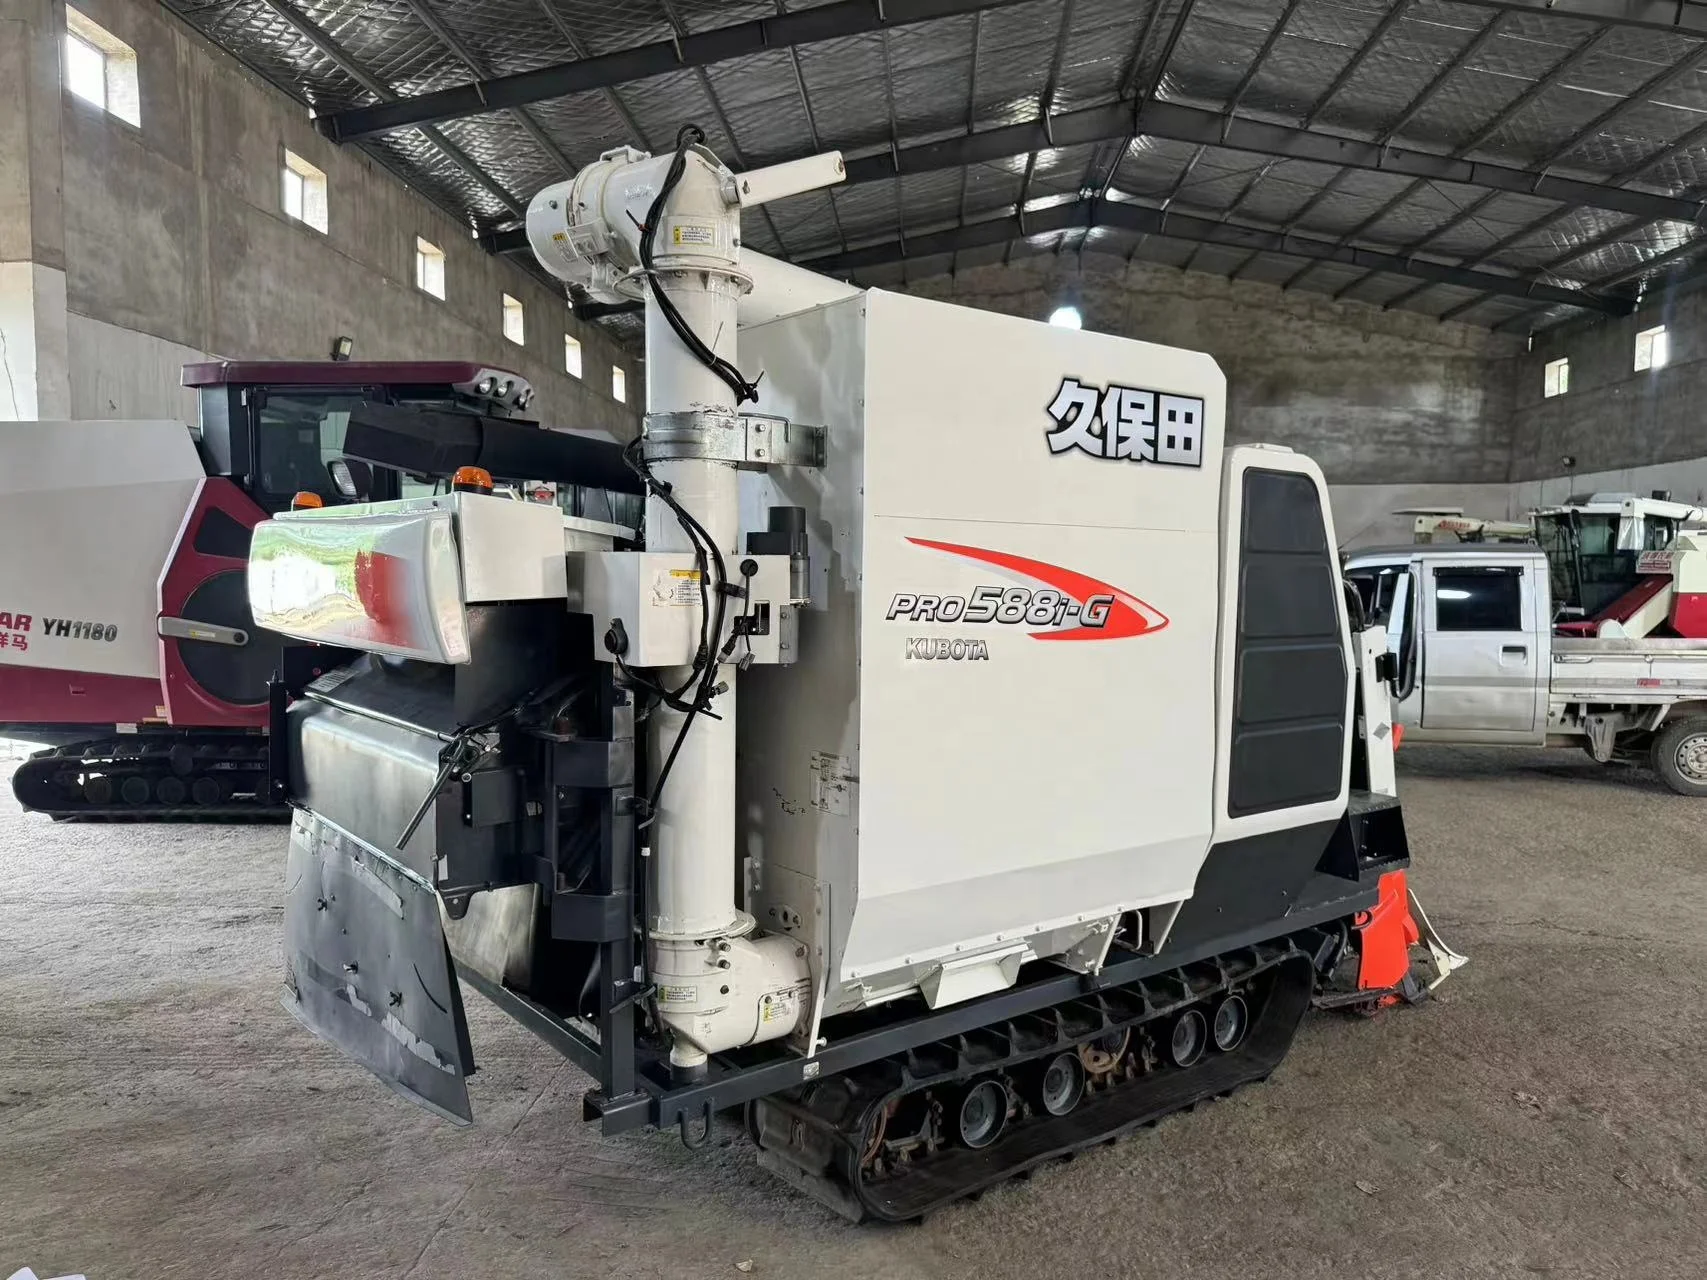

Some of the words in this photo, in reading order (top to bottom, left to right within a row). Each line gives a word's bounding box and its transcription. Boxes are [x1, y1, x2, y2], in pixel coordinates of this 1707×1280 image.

[1046, 377, 1205, 468] 久保田
[42, 617, 118, 642] YH1180
[905, 637, 989, 661] KUBOTA
